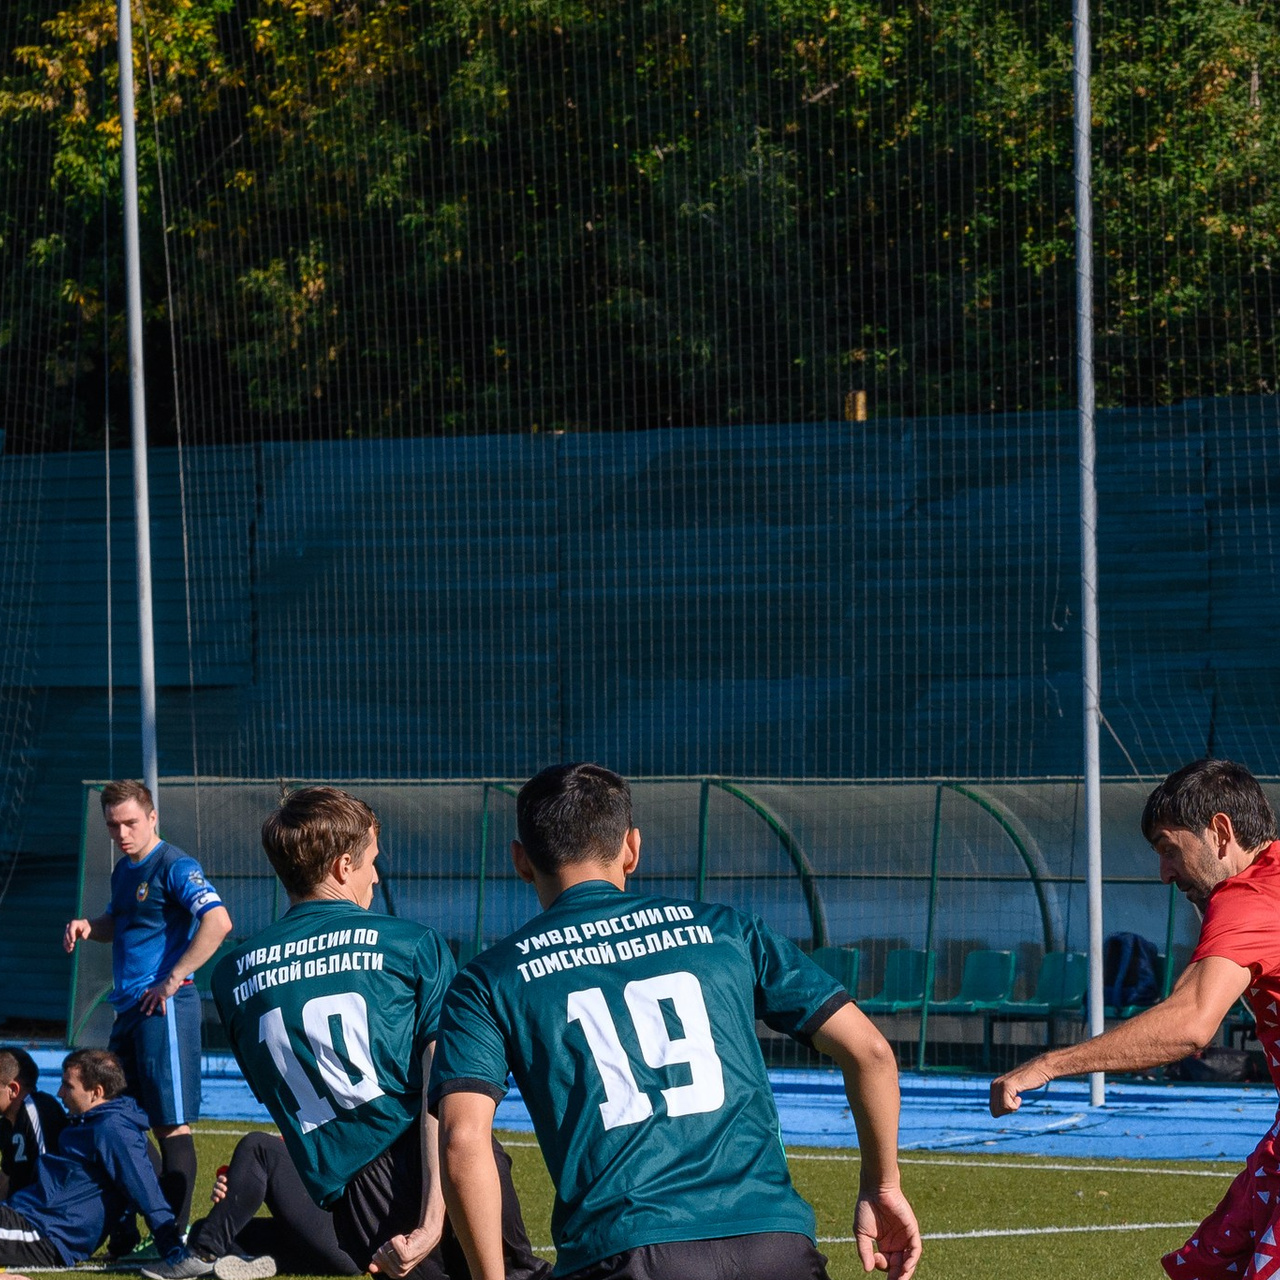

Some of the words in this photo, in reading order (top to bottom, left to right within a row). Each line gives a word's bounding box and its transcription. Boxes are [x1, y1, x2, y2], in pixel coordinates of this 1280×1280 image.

[236, 944, 282, 976] УМВД
[284, 929, 352, 959] РОССИИ
[353, 928, 379, 946] ПО
[515, 925, 583, 955] УМВД
[580, 907, 664, 940] РОССИИ
[663, 905, 694, 922] ПО
[517, 941, 617, 983] ТОМСКОЙ
[615, 925, 714, 961] ОБЛАСТИ
[232, 960, 301, 1006] ТОМСКОЙ
[304, 952, 384, 978] ОБЛАСТИ
[258, 992, 386, 1134] 10
[566, 971, 724, 1131] 19
[12, 1133, 28, 1162] 2
